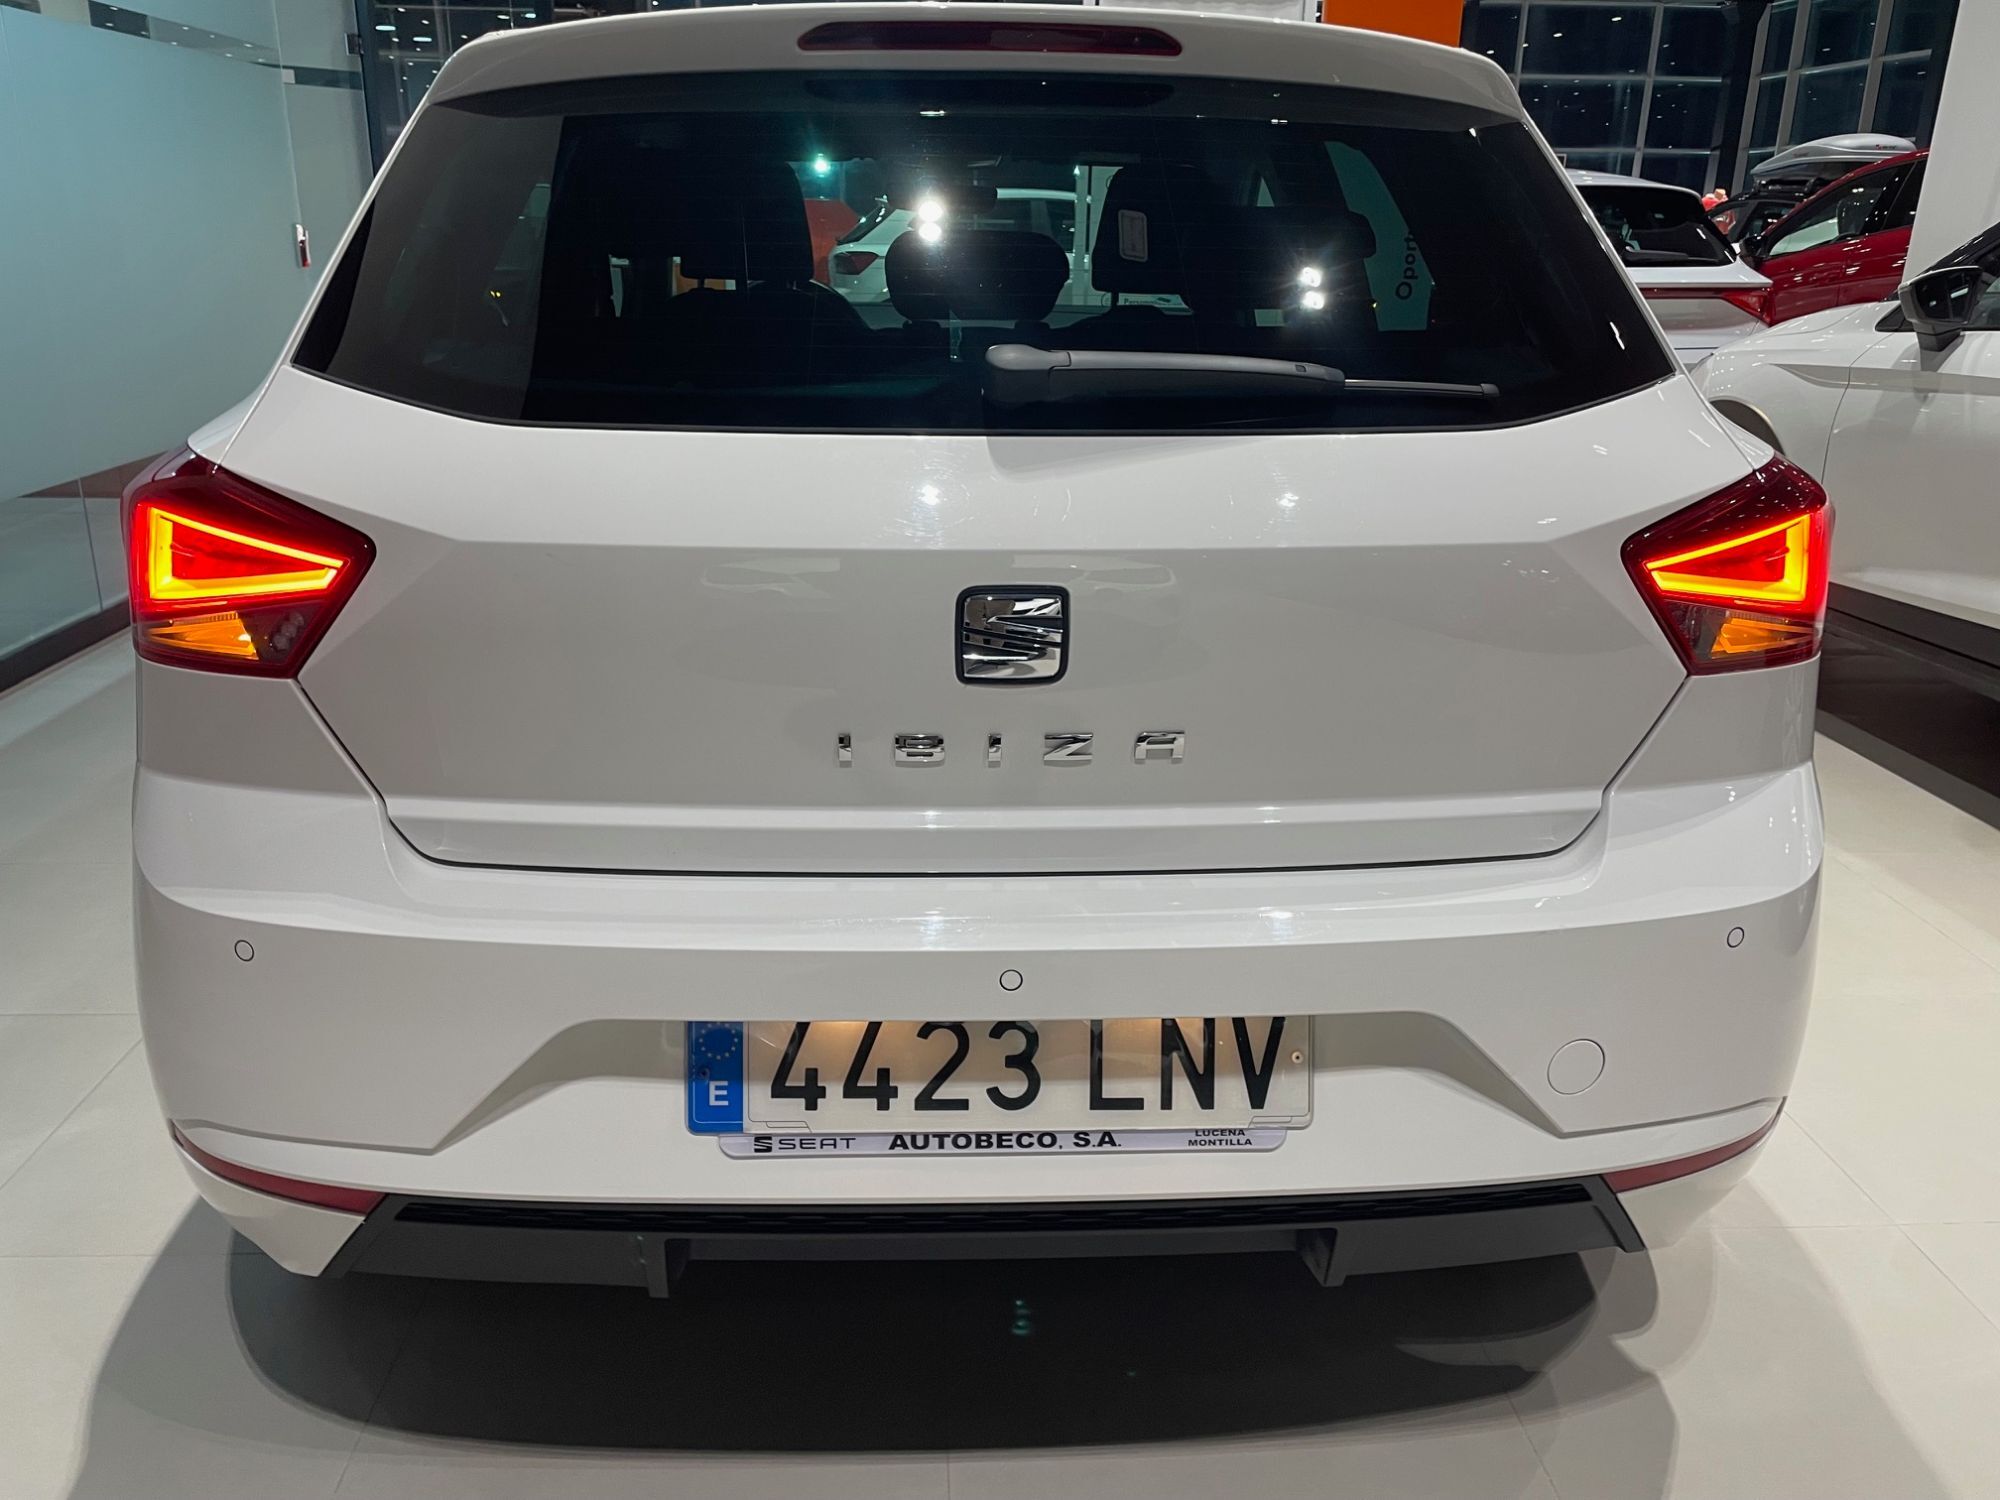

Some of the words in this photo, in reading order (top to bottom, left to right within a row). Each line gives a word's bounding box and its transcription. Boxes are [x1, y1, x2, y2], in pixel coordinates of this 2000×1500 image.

[838, 731, 1185, 762] IBIZA
[771, 1020, 1041, 1110] 4423
[1089, 1016, 1286, 1110] LNV
[708, 1081, 729, 1105] E
[889, 1133, 1063, 1150] AUTOBECO,
[1073, 1131, 1122, 1147] S.A.
[1187, 1138, 1253, 1147] MONTILLA
[1194, 1128, 1246, 1138] LUCENA
[778, 1137, 857, 1150] SEAT
